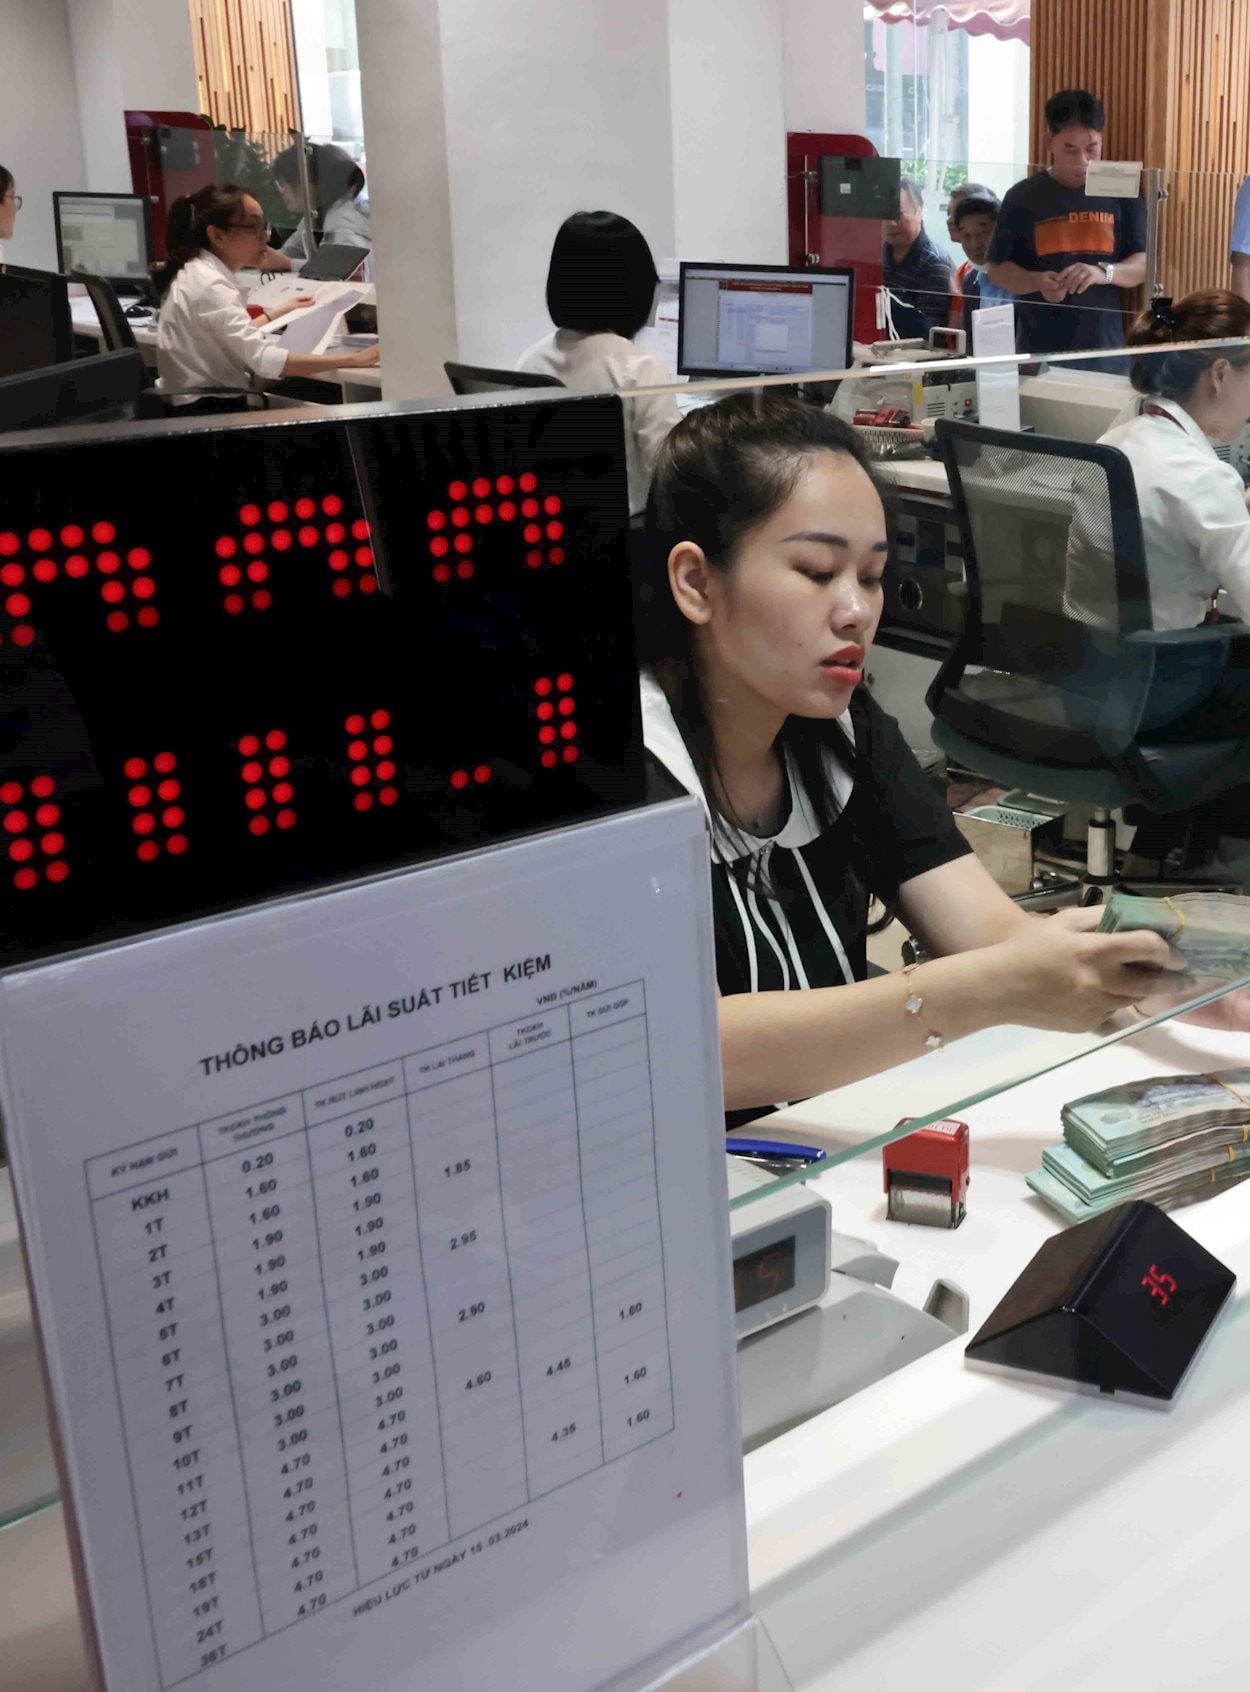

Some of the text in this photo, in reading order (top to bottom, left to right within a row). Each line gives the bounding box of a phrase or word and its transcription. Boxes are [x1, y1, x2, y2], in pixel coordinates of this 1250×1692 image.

[1068, 211, 1115, 225] DENIM
[199, 953, 552, 1076] THÔNG BÁO LÃI SUẤT TIẾT KIỆM
[131, 1117, 375, 1212] KKH 0.20 0.20
[144, 1142, 377, 1236] 1T 1.60 1.60
[148, 1158, 472, 1263] 2T 1.60 1.60 1.85
[152, 1192, 382, 1289] 3T 1.90 1.90
[155, 1216, 384, 1314] 4T 1.90 1.90
[258, 1280, 289, 1301] 1.90
[357, 1241, 386, 1261] 1.90
[449, 1229, 477, 1251] 2.95
[1141, 1263, 1178, 1306] 35
[165, 1290, 392, 1392] 7T 3.00 3.00
[260, 1304, 291, 1327] 3.00
[360, 1265, 389, 1286] 3.00
[267, 1354, 298, 1378] 3.00
[366, 1314, 395, 1336] 3.00
[458, 1301, 486, 1323] 2.90
[619, 1301, 643, 1322] 1.60
[173, 1362, 401, 1470] 10T 3.00 3.00
[270, 1379, 302, 1402] 3.00
[369, 1338, 398, 1360] 3.00
[177, 1474, 205, 1496] 11T
[277, 1429, 308, 1452] 3.00
[375, 1386, 404, 1408] 3.00
[623, 1366, 648, 1386] 1.60
[180, 1409, 406, 1521] 12T 4.70 4.70
[286, 1500, 316, 1522] 4.70
[382, 1455, 411, 1477] 4.70
[626, 1407, 651, 1428] 1.60
[183, 1433, 408, 1545] 13T 4.70 4.70
[288, 1523, 318, 1545] 4.70
[384, 1478, 412, 1499] 4.70
[193, 1501, 414, 1617] 19T 4.70 4.70
[196, 1523, 417, 1644] 24T 4.70 4.70
[297, 1592, 327, 1616] 4.70
[391, 1545, 419, 1567] 4.70
